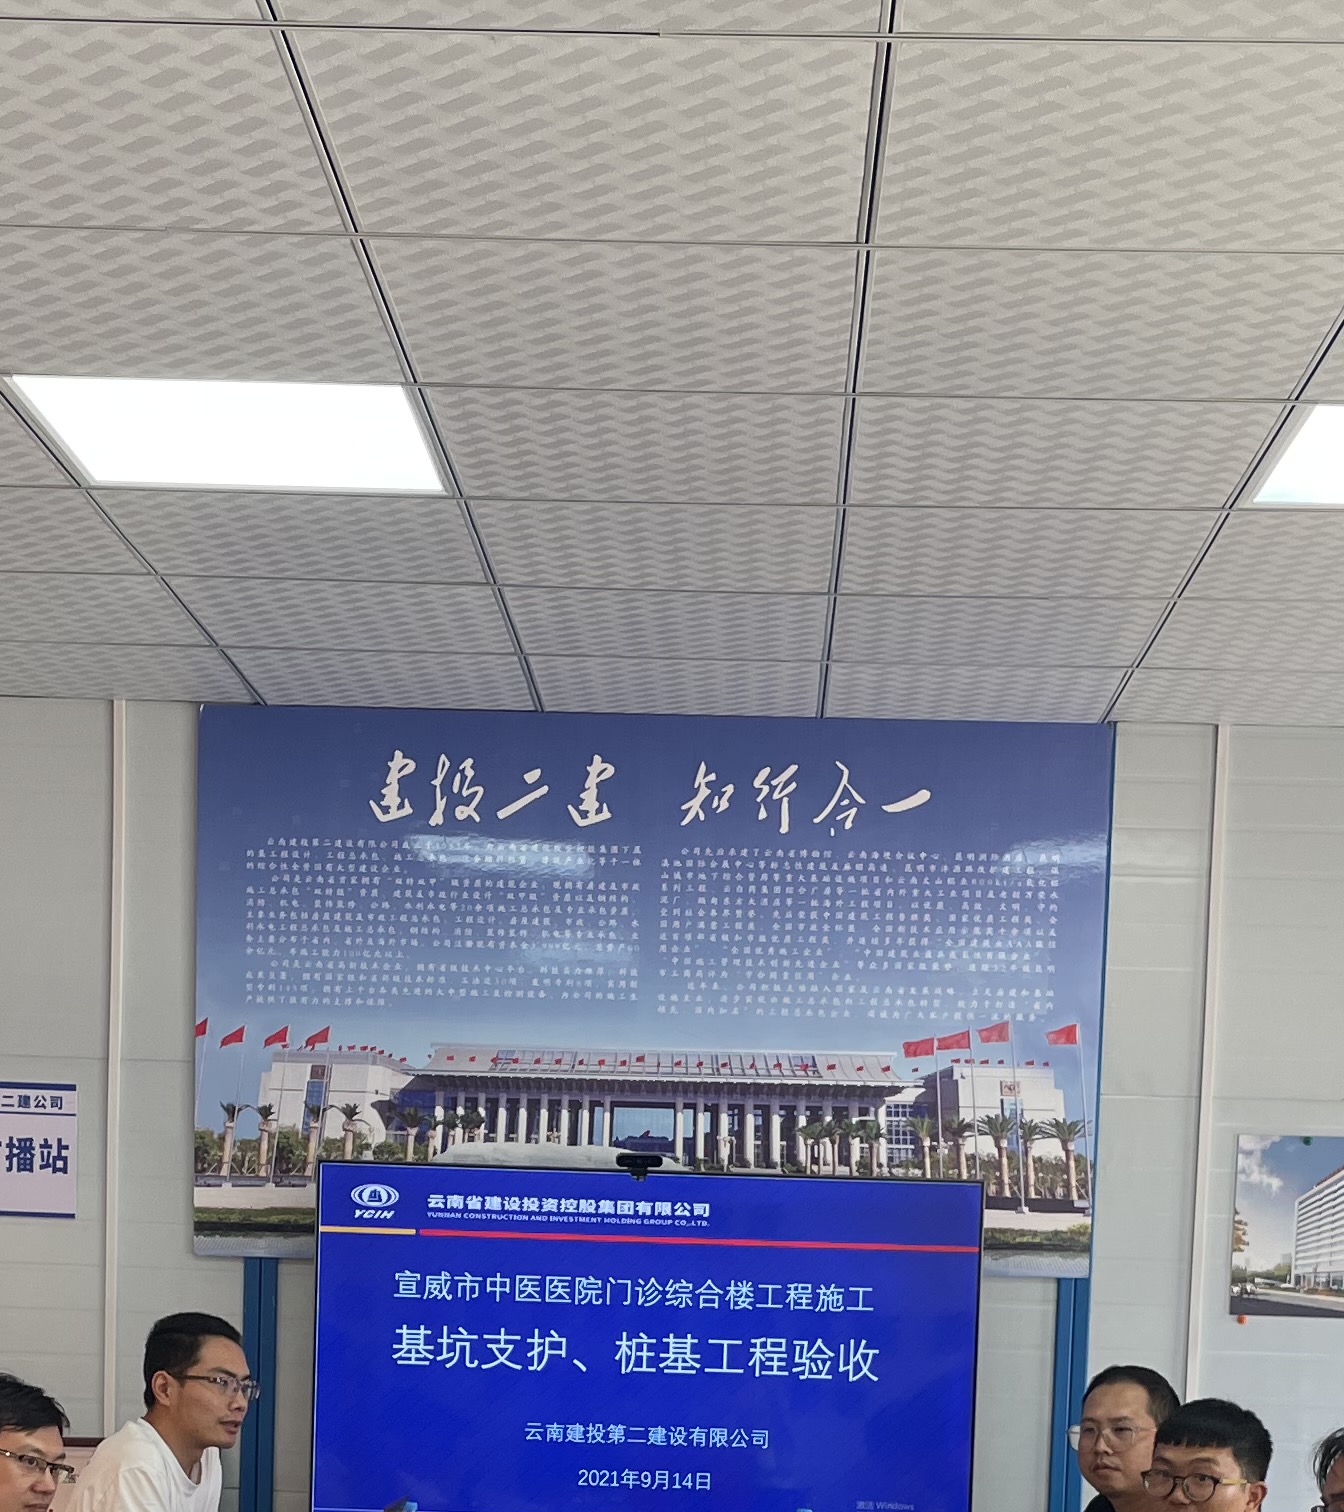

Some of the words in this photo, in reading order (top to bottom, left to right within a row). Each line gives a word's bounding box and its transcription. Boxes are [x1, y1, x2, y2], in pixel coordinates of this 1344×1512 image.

[369, 750, 616, 828] 建投二建
[680, 761, 932, 838] 知行合一
[1, 1094, 63, 1110] 二建公司
[354, 1209, 395, 1219] YCIH
[427, 1194, 710, 1218] 云南省建设投资控股集团有限公司
[427, 1211, 461, 1219] YUNNAN
[463, 1212, 528, 1221] CONSTRUCTION
[550, 1215, 601, 1223] INVESTMENT
[604, 1217, 642, 1225] HOLDING
[643, 1218, 672, 1226] GROUP
[393, 1269, 875, 1313] 宣威市中医医院门诊综合楼工程施工
[391, 1324, 880, 1383] 基坑支护、桩基工程验收
[524, 1421, 770, 1449] 云南建投第二建设有限公司
[577, 1468, 712, 1491] 2021年9月14日
